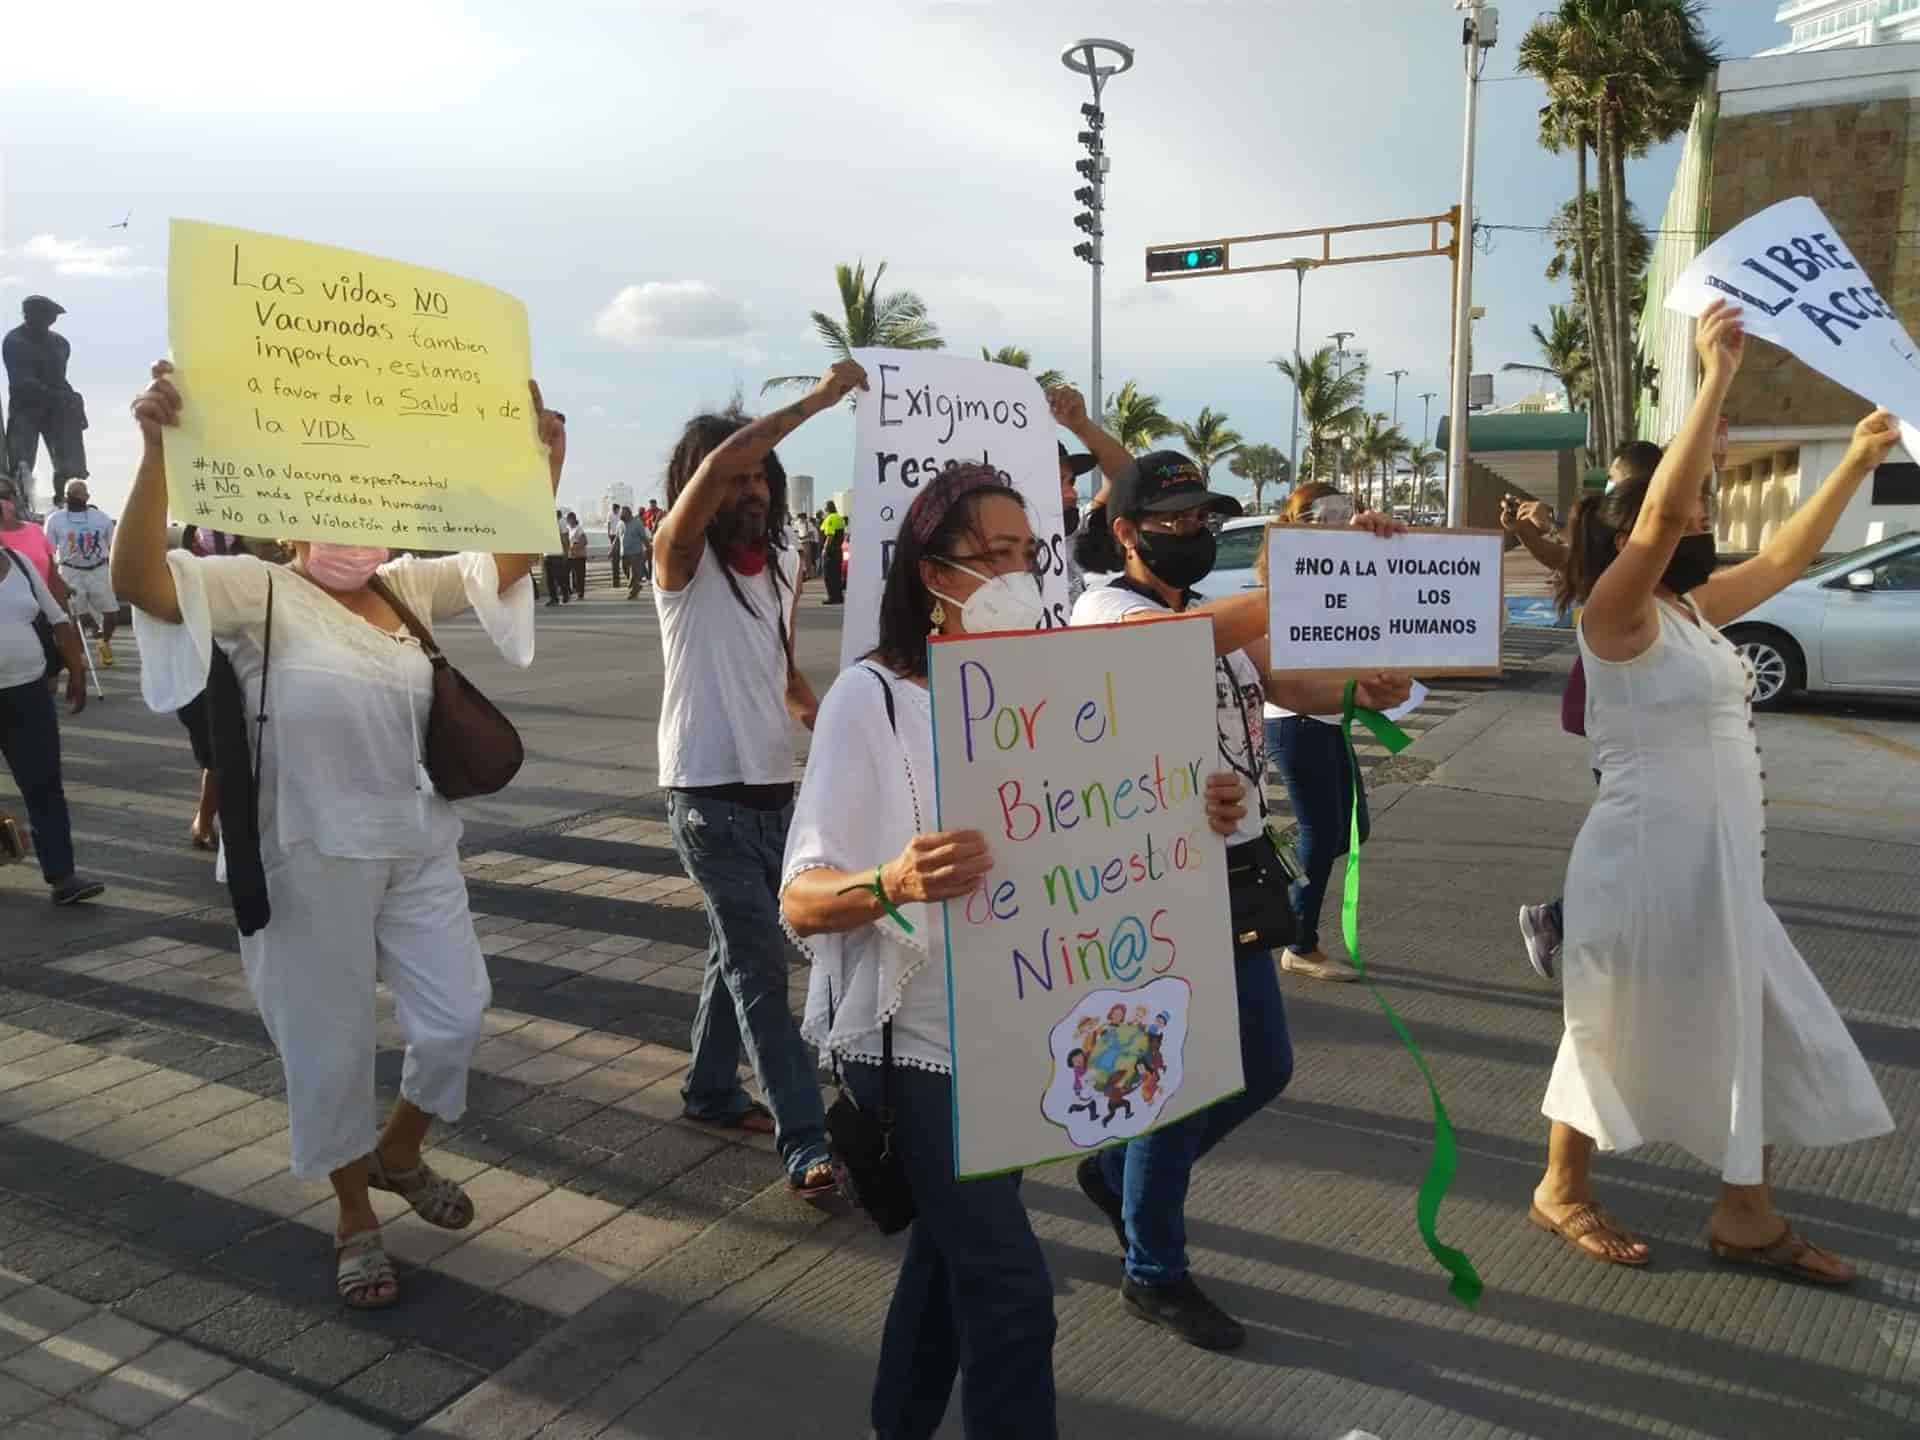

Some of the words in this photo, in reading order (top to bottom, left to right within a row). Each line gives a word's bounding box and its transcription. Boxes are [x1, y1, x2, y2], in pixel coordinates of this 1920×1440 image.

[232, 243, 305, 296] Las
[321, 271, 398, 309] vidas
[414, 287, 450, 315] NO
[1704, 233, 1857, 317] LIBRE
[255, 301, 395, 340] Vacunadas
[408, 327, 489, 355] tambien
[389, 358, 482, 385] estamos
[248, 376, 263, 395] a
[273, 377, 321, 401] favor
[328, 384, 353, 407] de
[366, 386, 385, 408] la
[400, 387, 460, 416] Salud
[476, 405, 487, 422] y
[498, 398, 522, 421] de
[879, 364, 1028, 444] Exigimos
[254, 408, 284, 435] la
[302, 417, 357, 442] VIDA
[350, 473, 448, 489] experimental
[392, 519, 409, 533] de
[1295, 557, 1334, 576] #NO
[1339, 560, 1351, 576] A
[1355, 560, 1377, 577] LA
[1387, 556, 1481, 577] VIOLACIÓN
[1325, 593, 1348, 609] DE
[1417, 589, 1451, 605] LOS
[1290, 625, 1381, 642] DERECHOS
[1389, 618, 1477, 635] HUMANOS
[959, 660, 1047, 763] Por
[1074, 671, 1118, 743] el
[997, 754, 1203, 842] Bienestar
[967, 873, 1019, 925] de
[1043, 828, 1204, 915] nuestros
